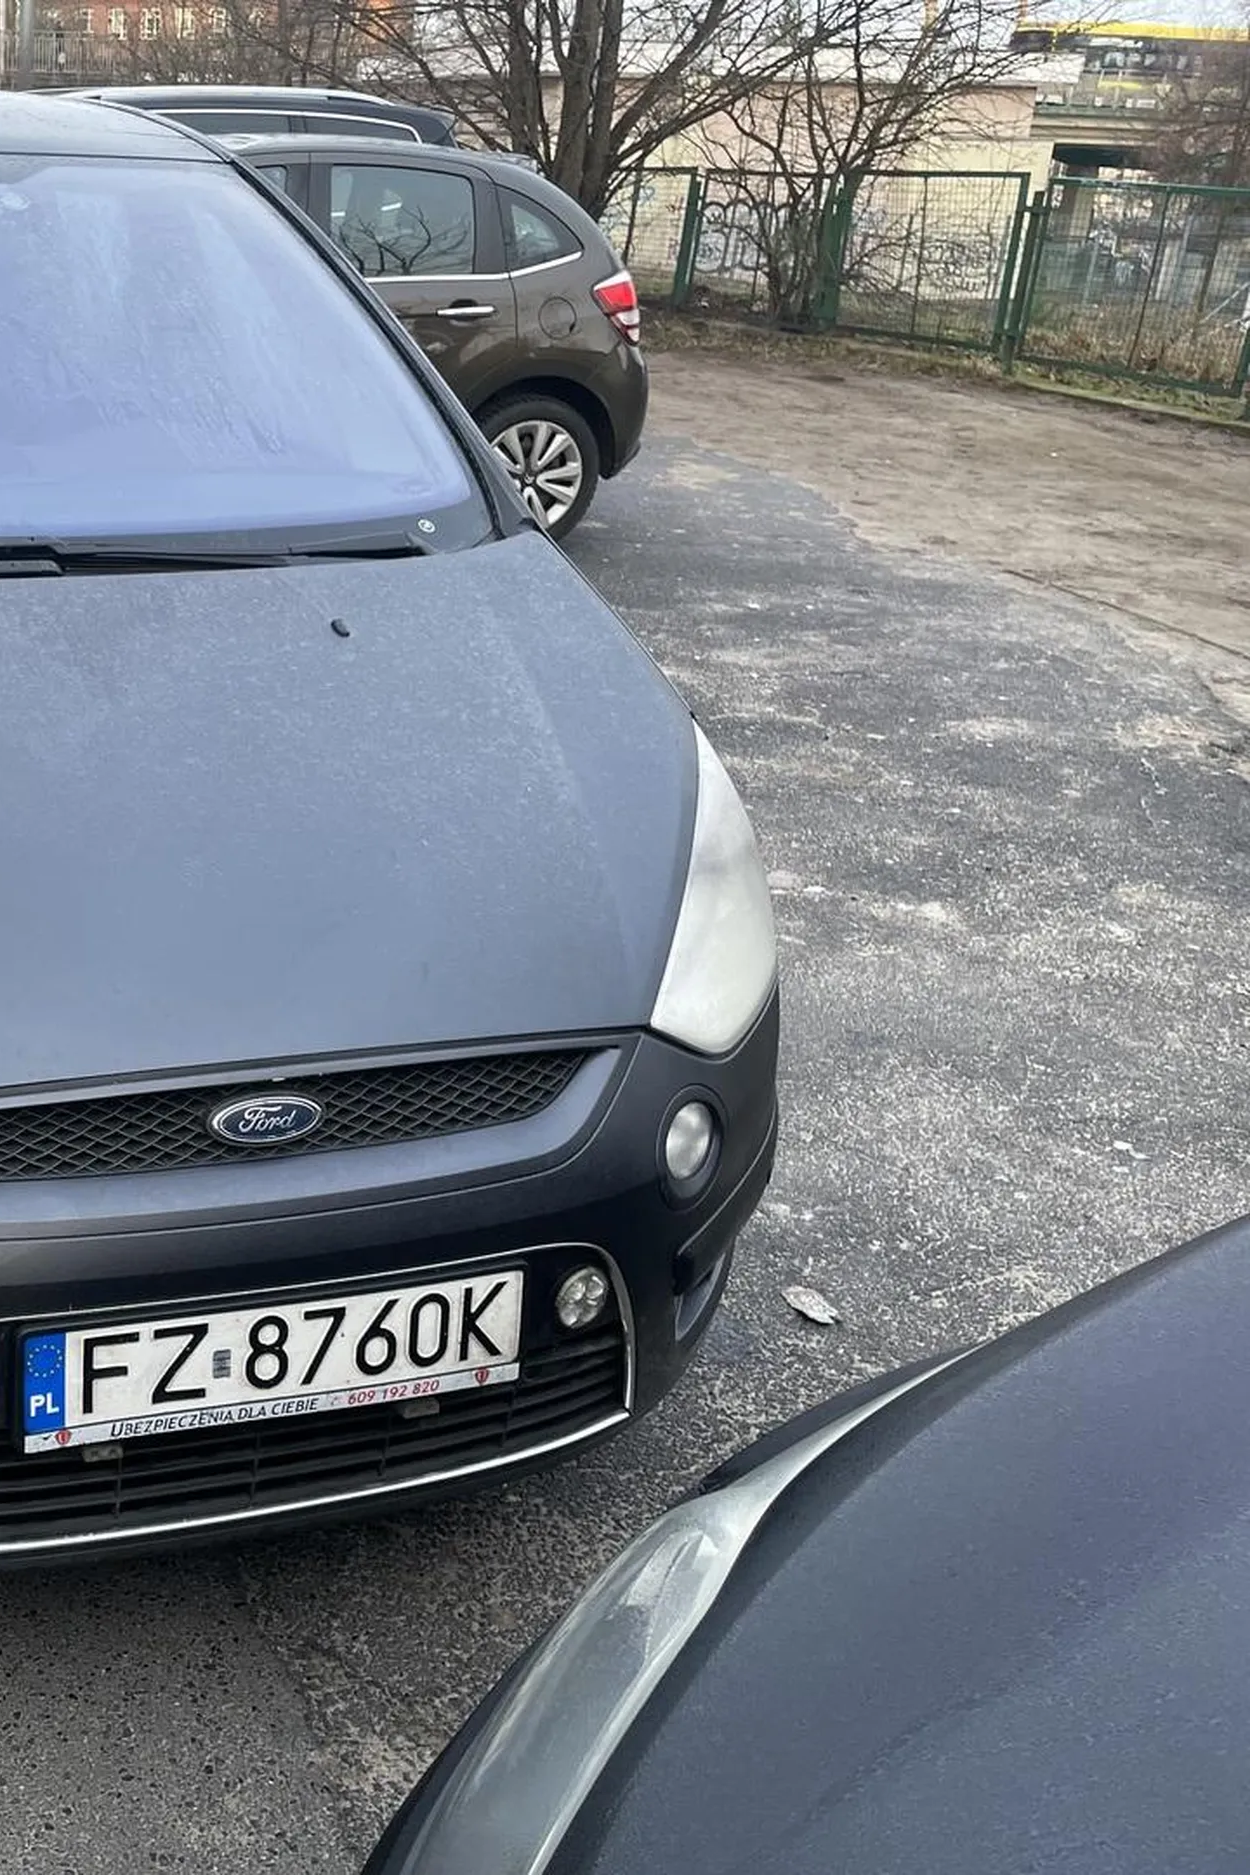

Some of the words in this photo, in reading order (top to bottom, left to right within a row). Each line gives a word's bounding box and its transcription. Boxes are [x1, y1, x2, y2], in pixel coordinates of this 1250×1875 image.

[239, 1105, 296, 1132] Ford
[83, 1322, 209, 1414] FZ
[245, 1280, 508, 1390] 8760K
[30, 1392, 60, 1417] PL
[111, 1407, 235, 1437] UBEZPIECZENIA
[237, 1406, 266, 1420] DLA
[271, 1397, 319, 1416] CIEBIE
[347, 1389, 376, 1405] 609
[383, 1385, 407, 1400] 192
[412, 1378, 440, 1394] 820
